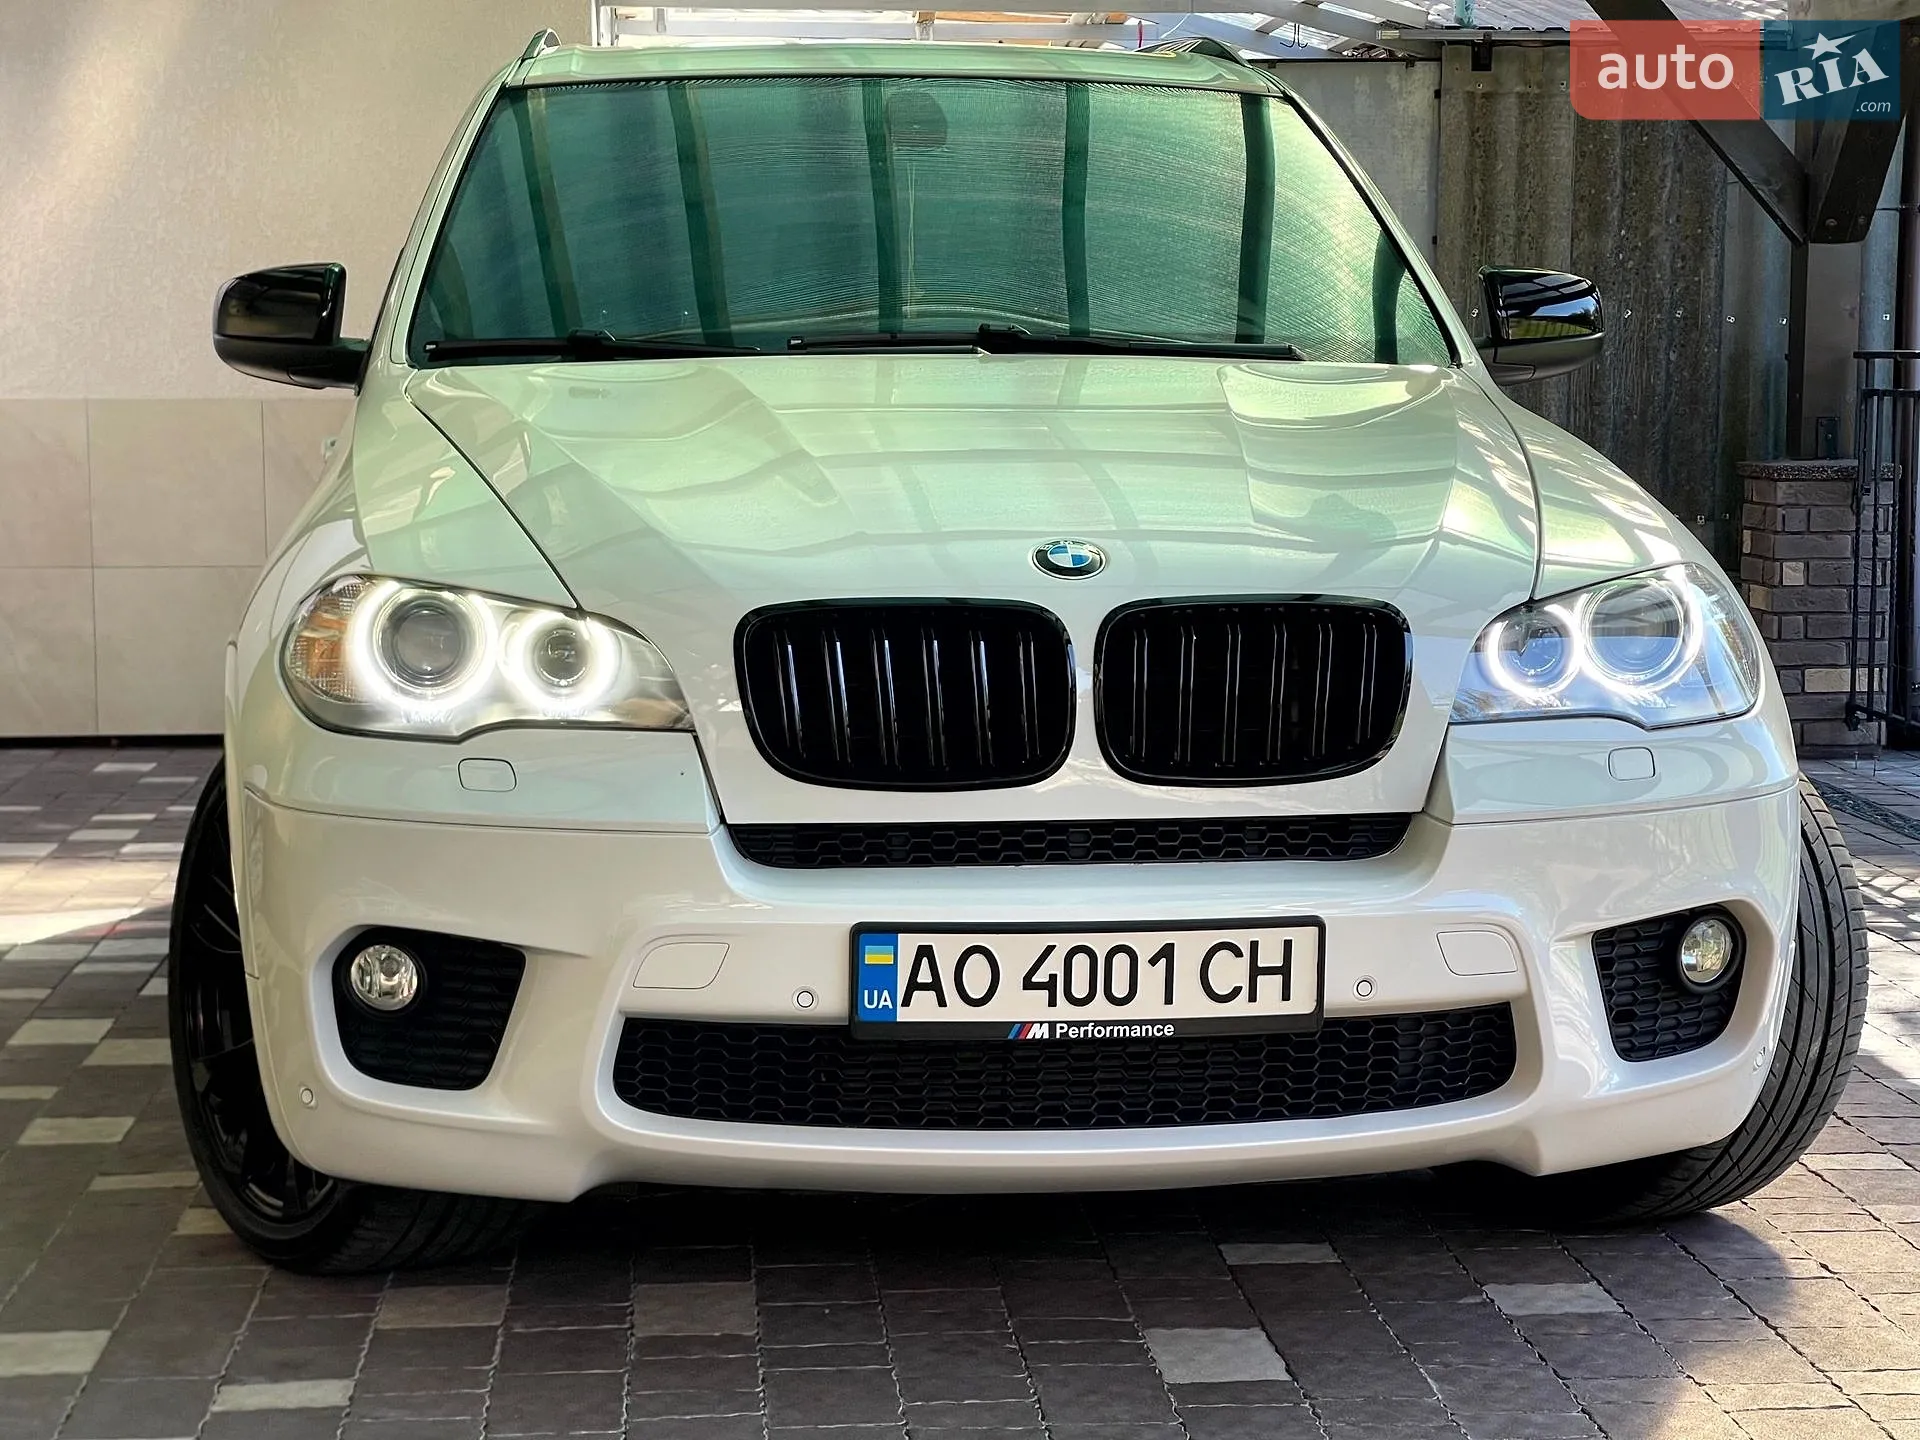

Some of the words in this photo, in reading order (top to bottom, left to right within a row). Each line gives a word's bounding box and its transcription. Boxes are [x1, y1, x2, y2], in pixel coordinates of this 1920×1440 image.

[900, 944, 1001, 1008] AO
[1022, 943, 1175, 1008] 4001
[1199, 938, 1293, 1004] CH
[863, 989, 894, 1009] UA
[1055, 1022, 1175, 1039] Performance
